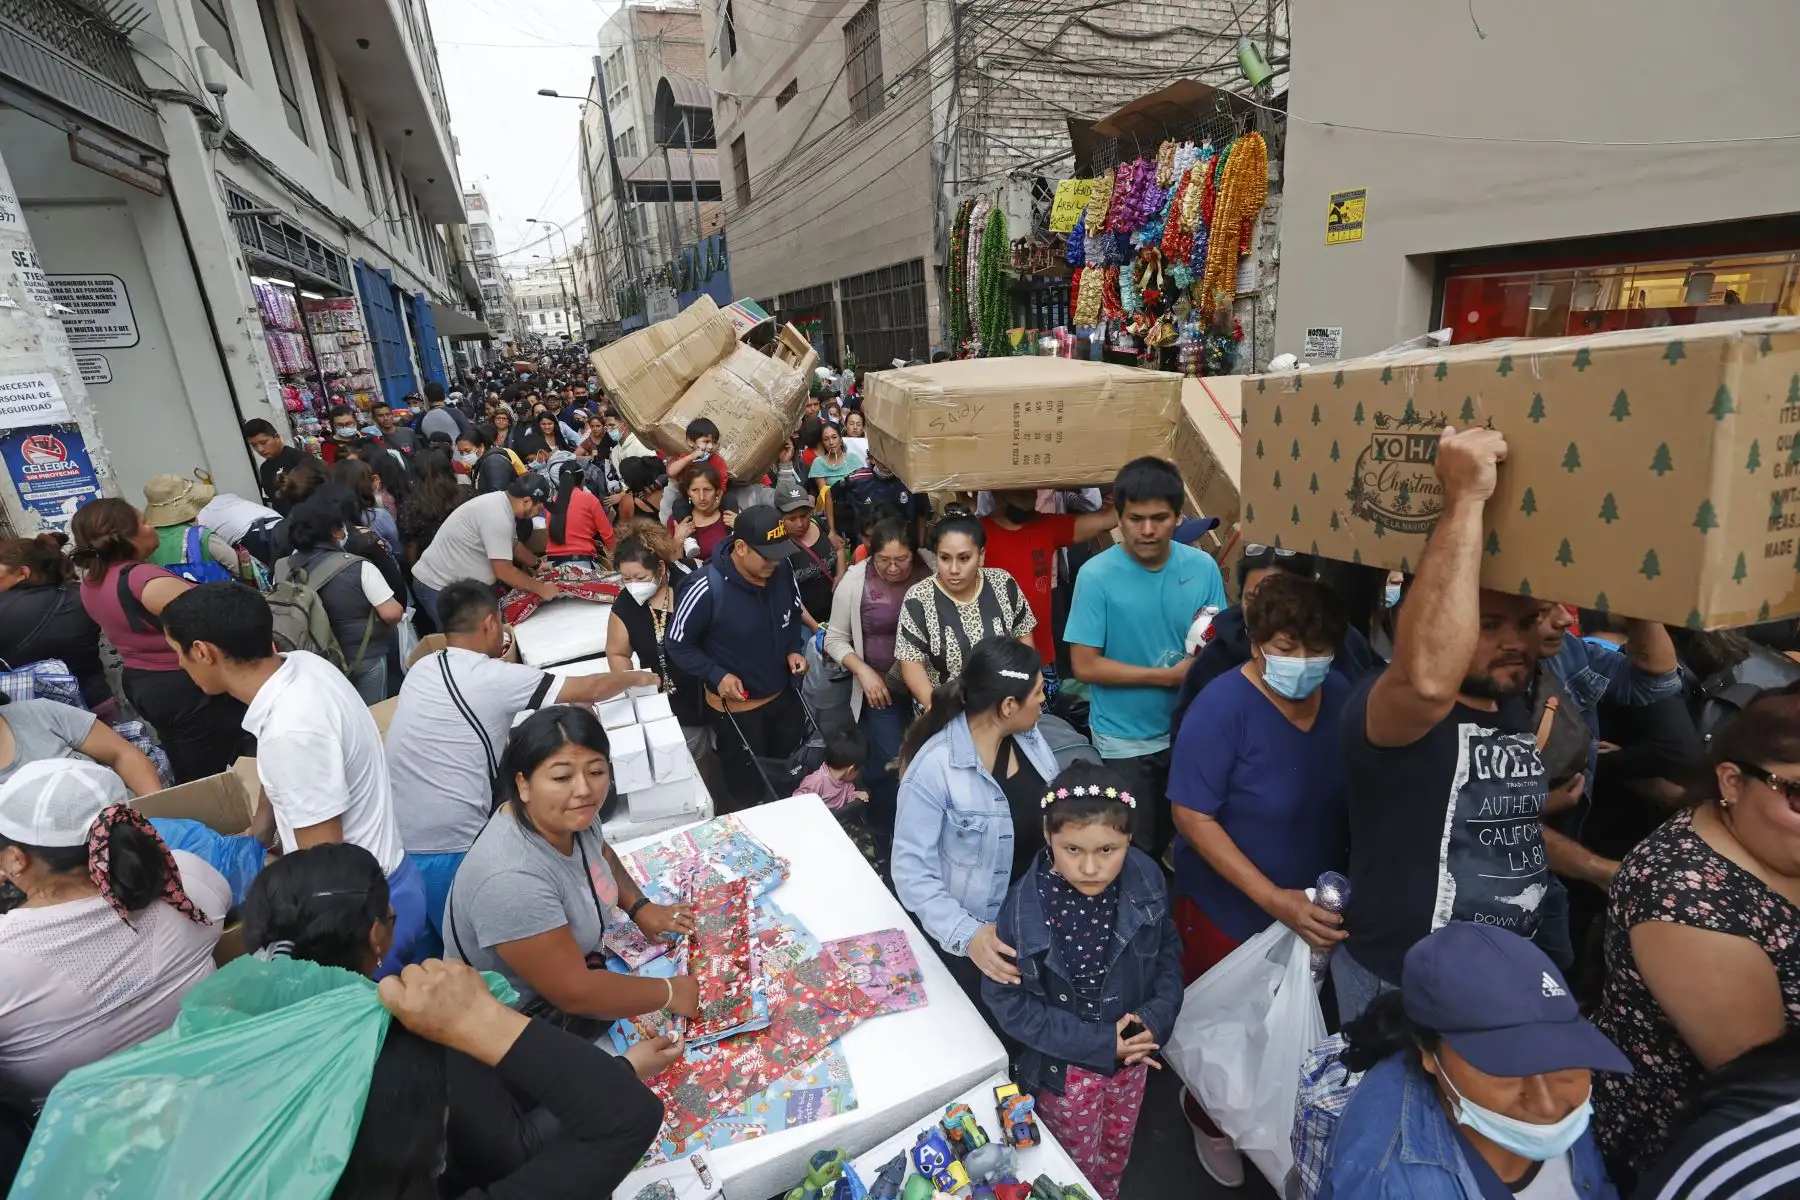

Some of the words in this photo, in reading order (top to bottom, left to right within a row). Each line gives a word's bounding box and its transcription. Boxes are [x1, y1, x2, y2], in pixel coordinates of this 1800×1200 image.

[1073, 181, 1092, 197] VEND
[1328, 222, 1362, 231] PROSEGUR
[0, 392, 37, 403] RSONAL
[38, 391, 53, 399] DE
[1779, 407, 1800, 425] ITE
[22, 459, 80, 474] CELEBRA
[26, 472, 39, 481] SIN
[39, 469, 81, 480] PIROTECNIA
[1363, 461, 1447, 496] Christma
[1764, 539, 1793, 559] MADE
[1506, 780, 1539, 789] TRADITION
[1479, 793, 1549, 817] AUTHENT
[1479, 823, 1545, 846] CALIFOR
[1508, 850, 1534, 871] LA
[1474, 911, 1520, 927] DOWN
